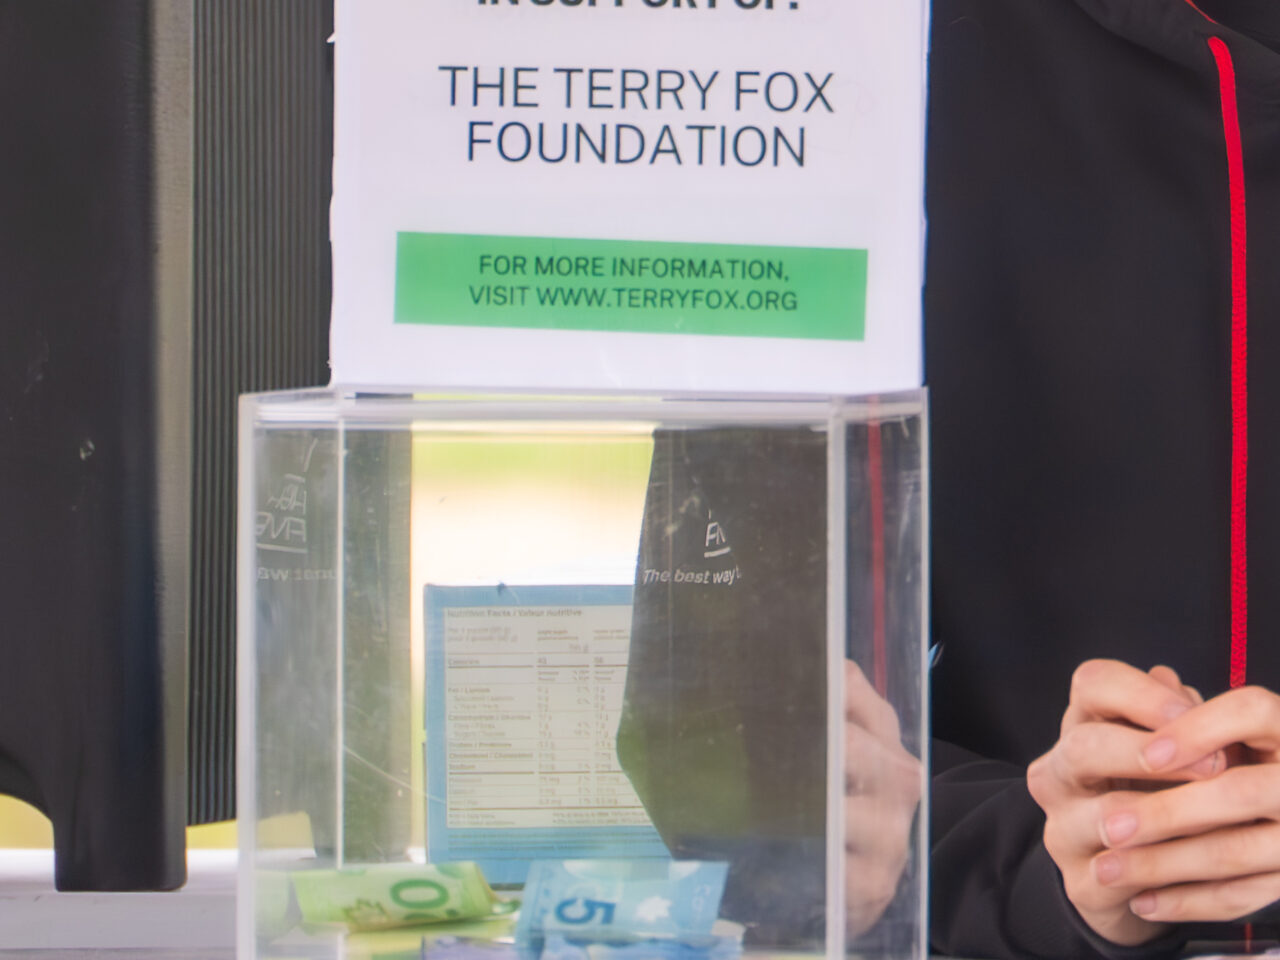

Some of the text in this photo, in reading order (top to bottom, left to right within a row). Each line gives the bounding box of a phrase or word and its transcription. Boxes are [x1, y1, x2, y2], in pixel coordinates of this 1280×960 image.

[438, 66, 835, 113] THE TERRY FOX
[467, 121, 806, 167] FOUNDATION
[478, 255, 789, 282] FOR MORE INFORMATION,
[469, 286, 798, 312] VISIT WWW.TERRYFOX.ORG
[643, 569, 669, 584] The
[674, 569, 709, 583] best
